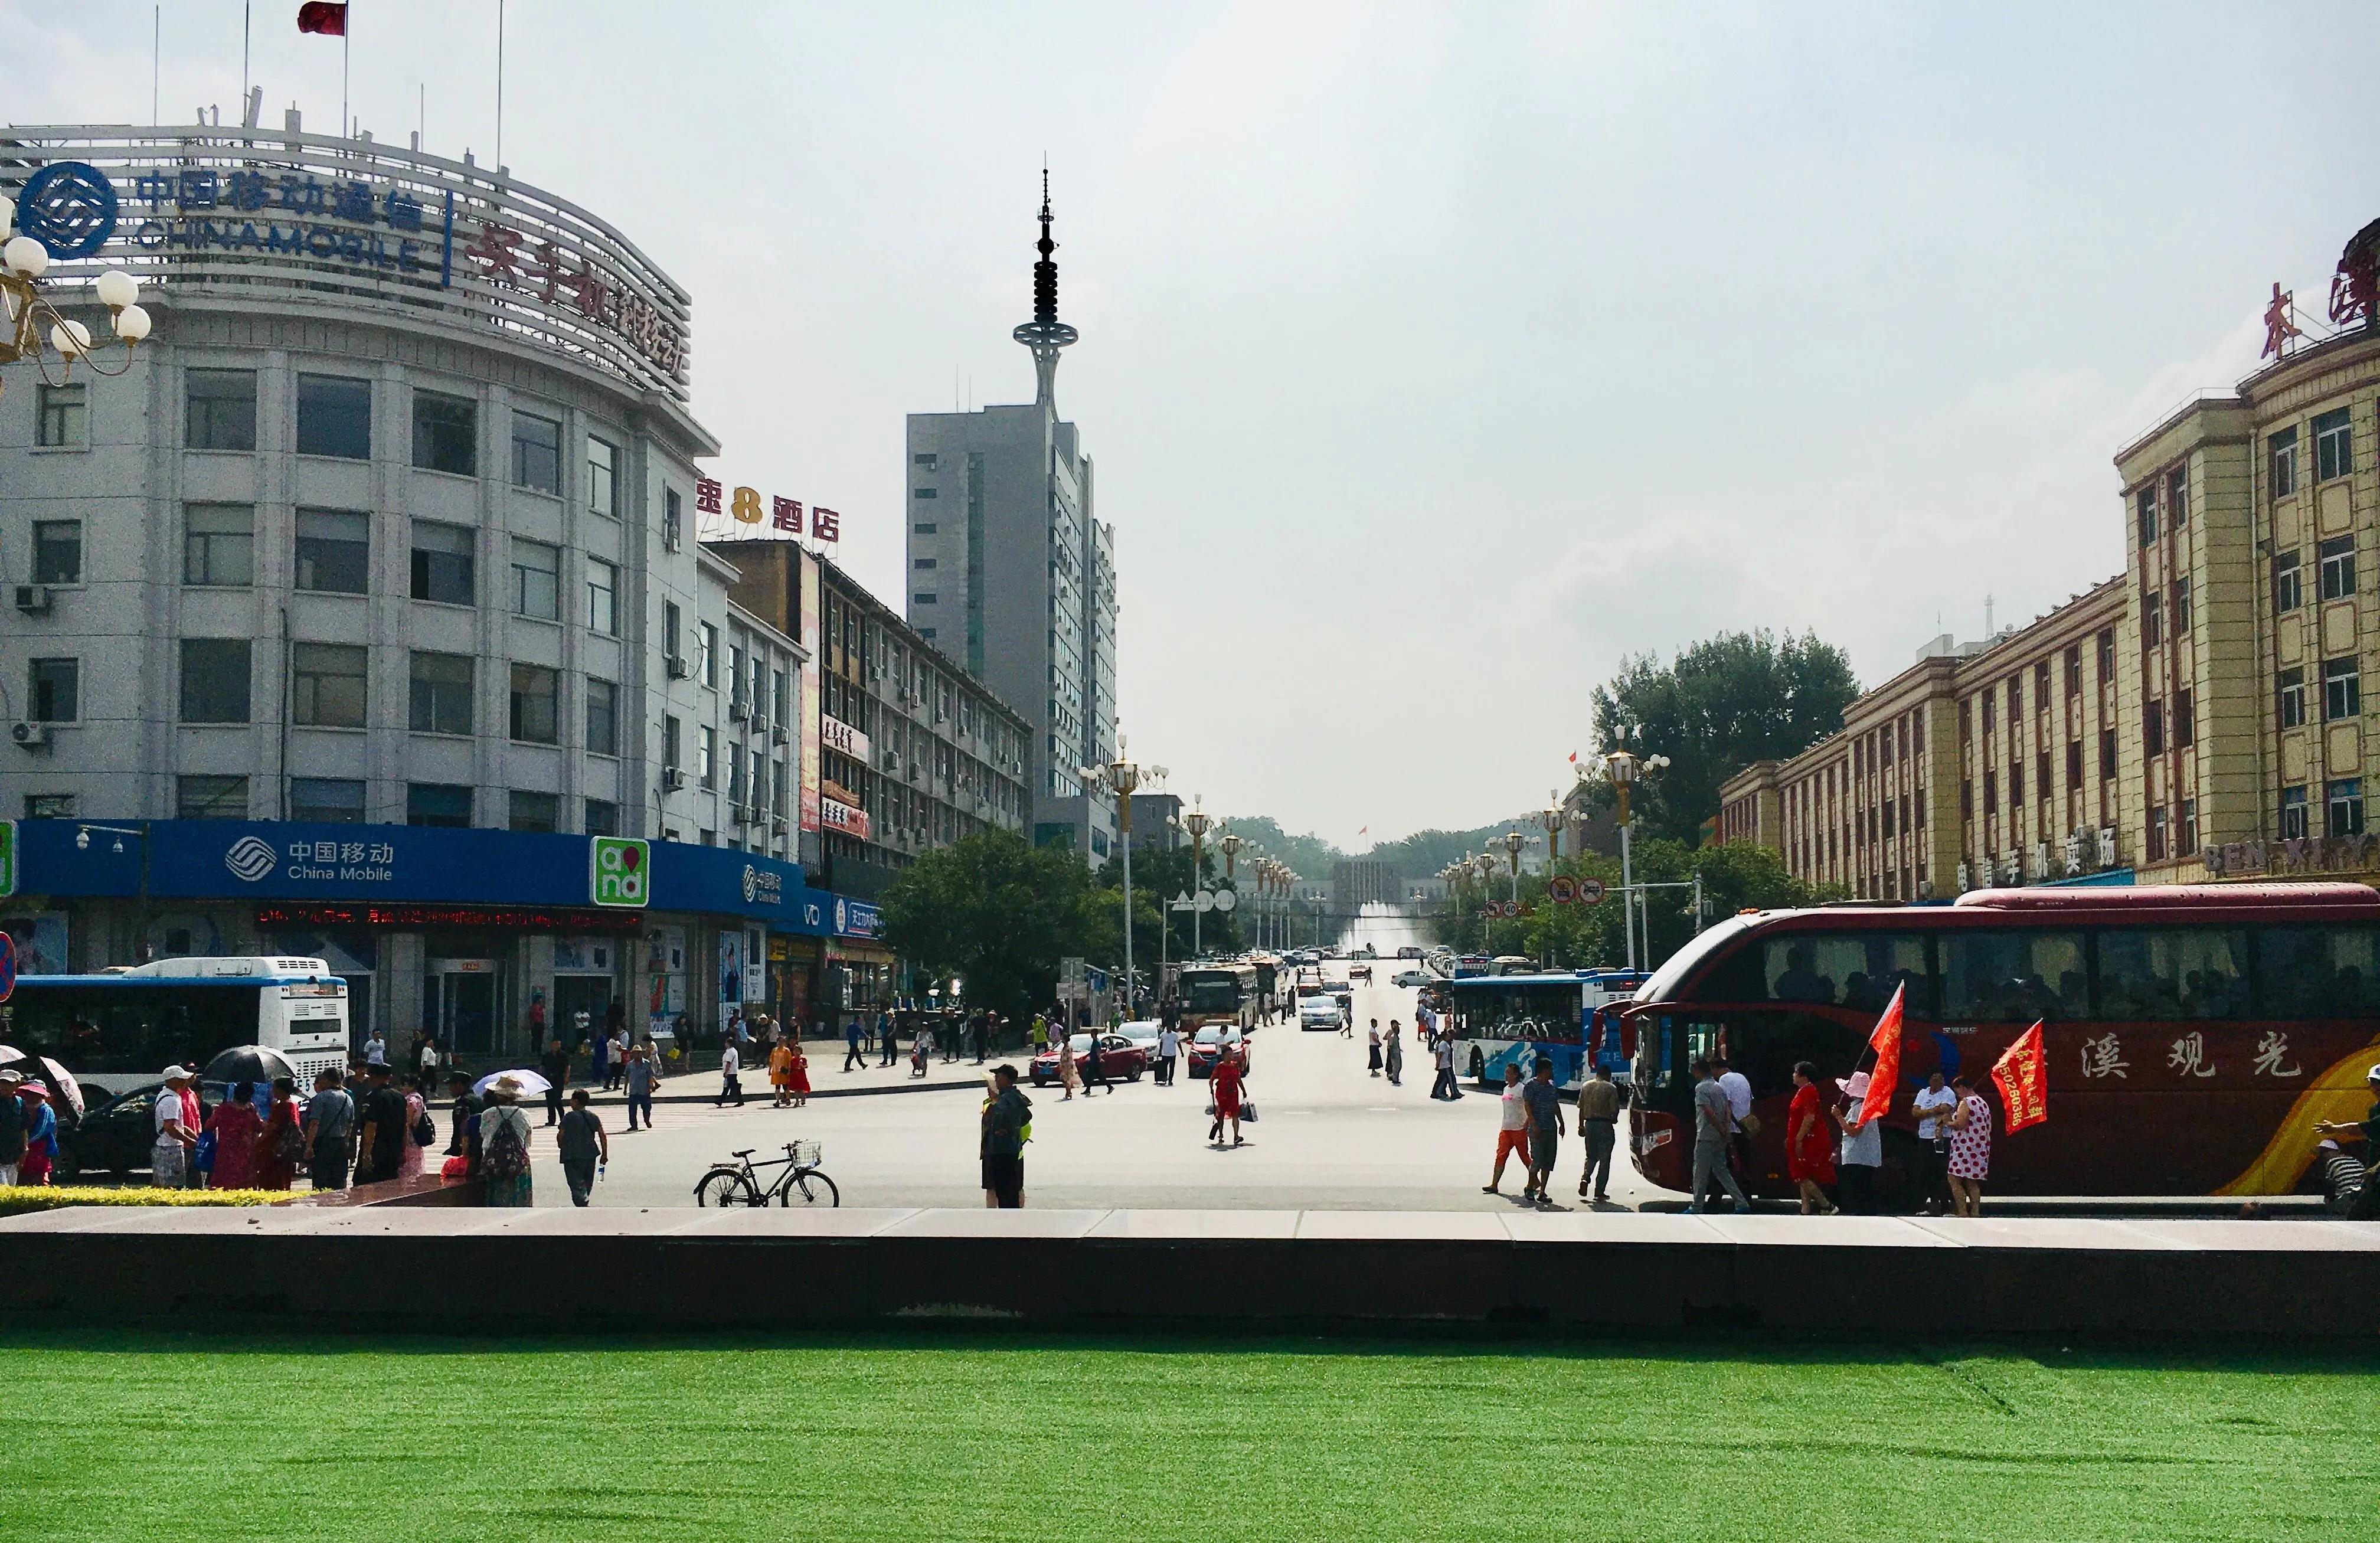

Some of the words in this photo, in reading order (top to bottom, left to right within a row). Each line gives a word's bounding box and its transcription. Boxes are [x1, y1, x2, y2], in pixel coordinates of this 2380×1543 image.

[137, 169, 423, 232] 中国移动通信
[289, 841, 394, 864] 中国移动
[2205, 841, 2267, 872] BEN
[288, 865, 335, 879] China
[340, 867, 393, 881] Mobile
[1506, 905, 1515, 914] 40
